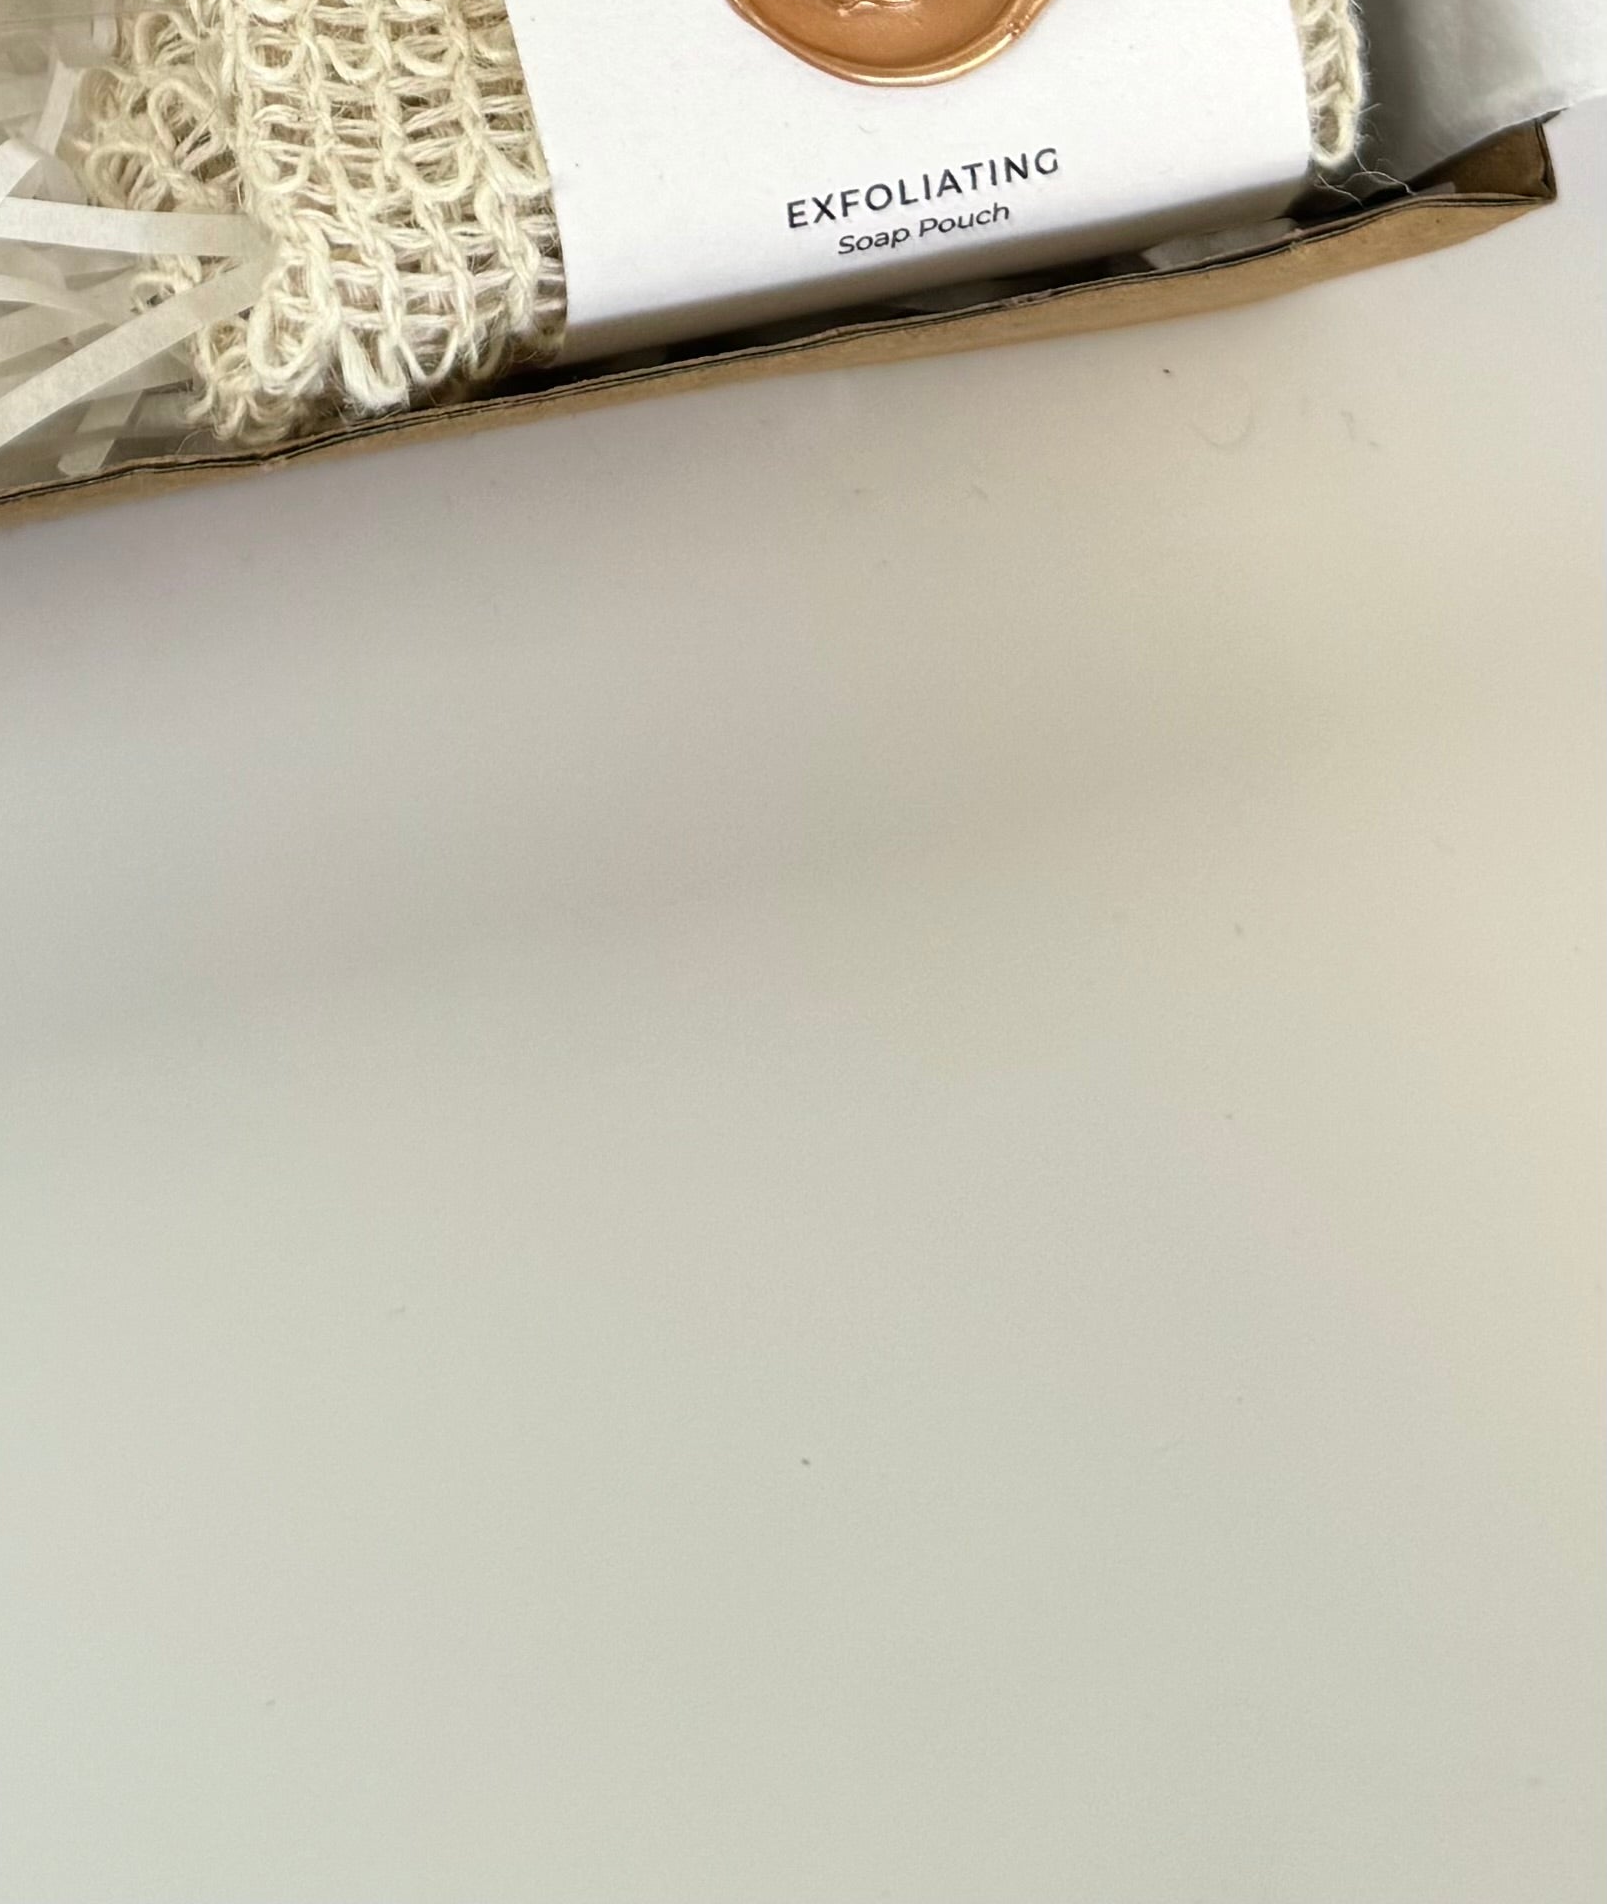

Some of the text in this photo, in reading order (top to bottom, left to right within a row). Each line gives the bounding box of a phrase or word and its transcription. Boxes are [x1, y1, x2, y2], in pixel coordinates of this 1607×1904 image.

[787, 148, 1058, 229] EXFOLIATING
[838, 202, 1009, 255] Soap Pouch
